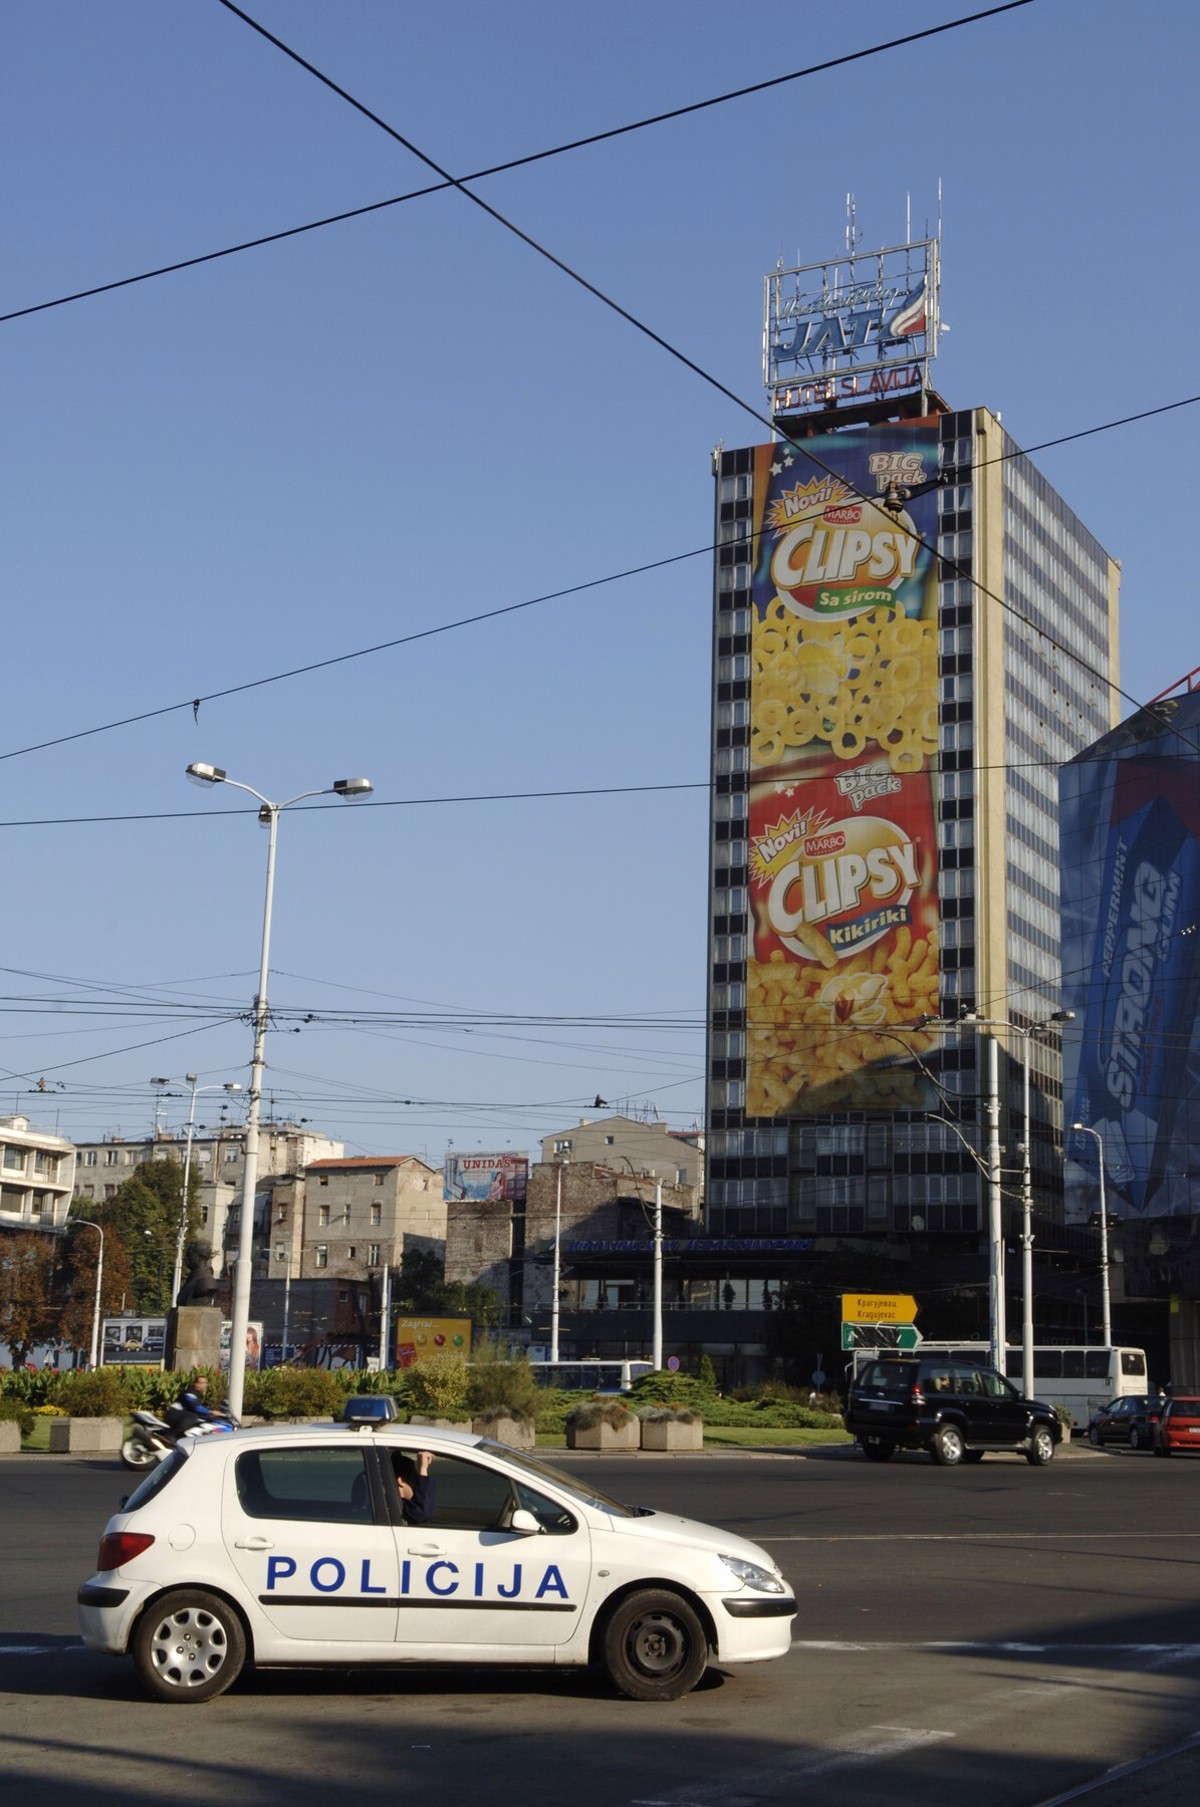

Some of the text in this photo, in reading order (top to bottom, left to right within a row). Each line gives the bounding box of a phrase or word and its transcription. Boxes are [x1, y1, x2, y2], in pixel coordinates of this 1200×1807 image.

[773, 308, 886, 359] JAT
[775, 364, 922, 410] HOTEL SLAVIJA
[870, 453, 923, 473] BIG
[877, 469, 926, 492] pack
[784, 487, 833, 518] Novi!
[824, 507, 861, 520] MARBO
[772, 523, 920, 589] CLIPSY
[820, 589, 892, 606] Sa sirom
[836, 765, 890, 793] BIG
[850, 777, 901, 811] pack
[757, 820, 807, 864] Novi!
[806, 834, 845, 852] MARBO
[768, 842, 921, 937] CLIPSY
[1102, 836, 1130, 977] PEPPERMINT
[830, 908, 907, 944] Kikiriki
[1157, 870, 1181, 961] GUM
[1108, 862, 1162, 1102] STRONG
[463, 1159, 511, 1169] UNIDAS
[857, 1299, 896, 1308] Крагујевац
[857, 1311, 896, 1320] Kragujevac
[265, 1555, 569, 1599] POLICIJA
